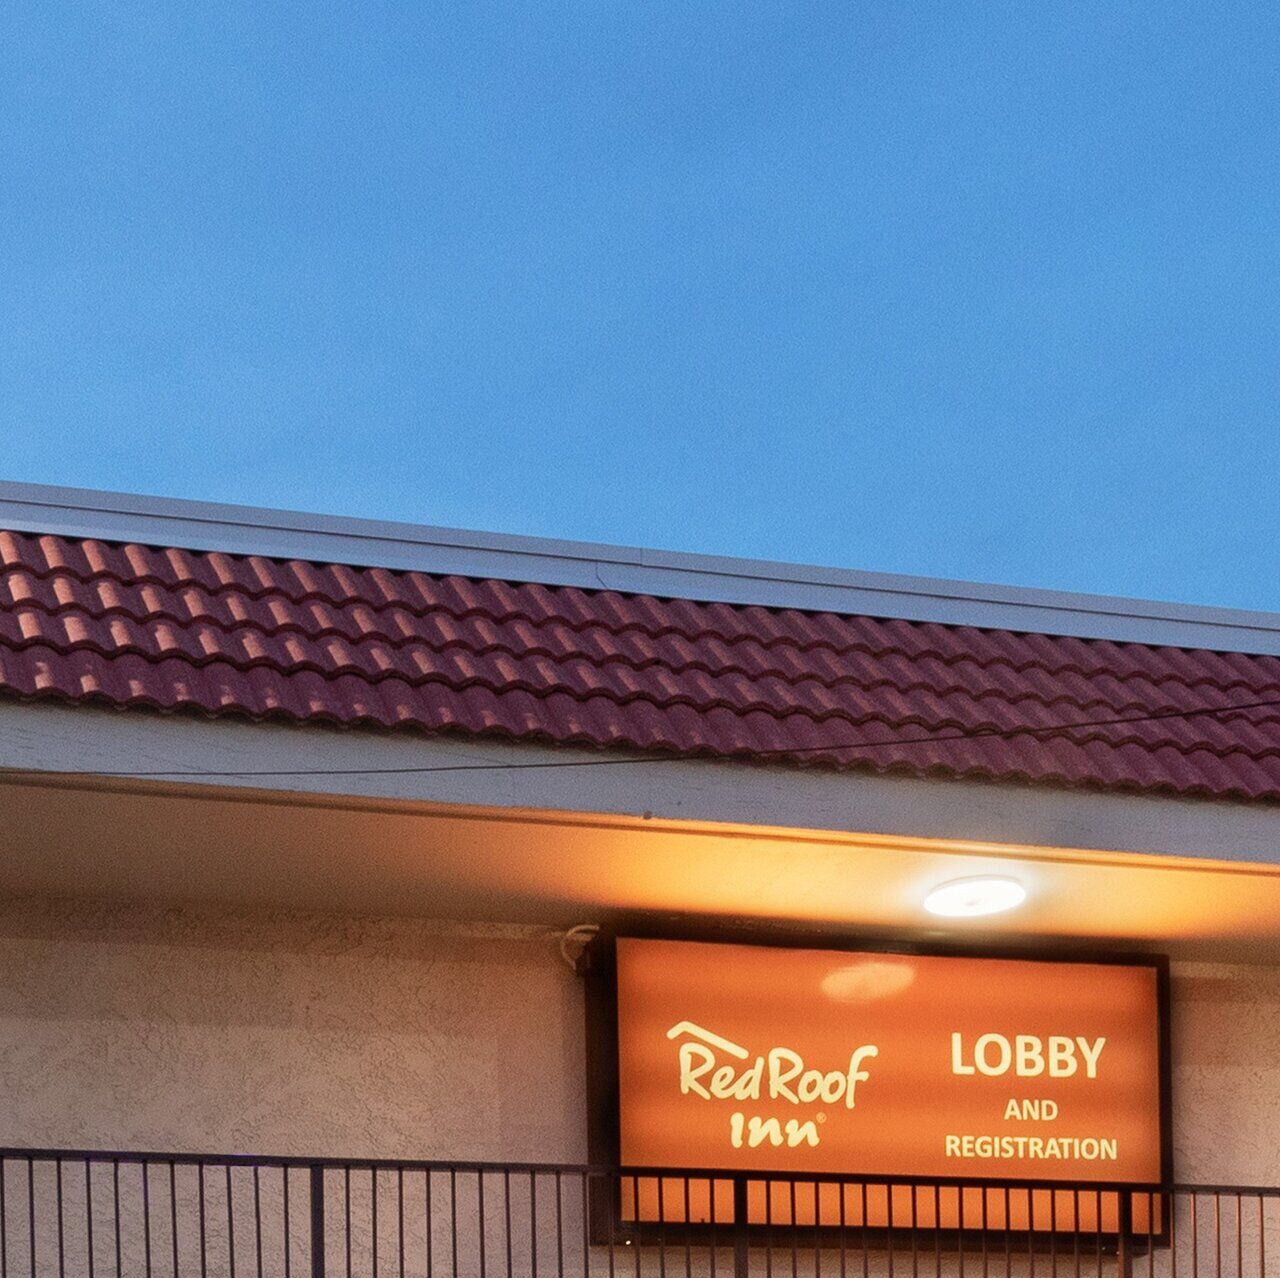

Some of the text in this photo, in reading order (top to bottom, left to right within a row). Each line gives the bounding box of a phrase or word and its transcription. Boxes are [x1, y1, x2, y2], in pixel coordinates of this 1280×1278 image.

[951, 1032, 1107, 1079] LOBBY
[679, 1042, 879, 1110] Red Roof
[1003, 1098, 1059, 1121] AND
[945, 1134, 1118, 1160] REGISTRATION
